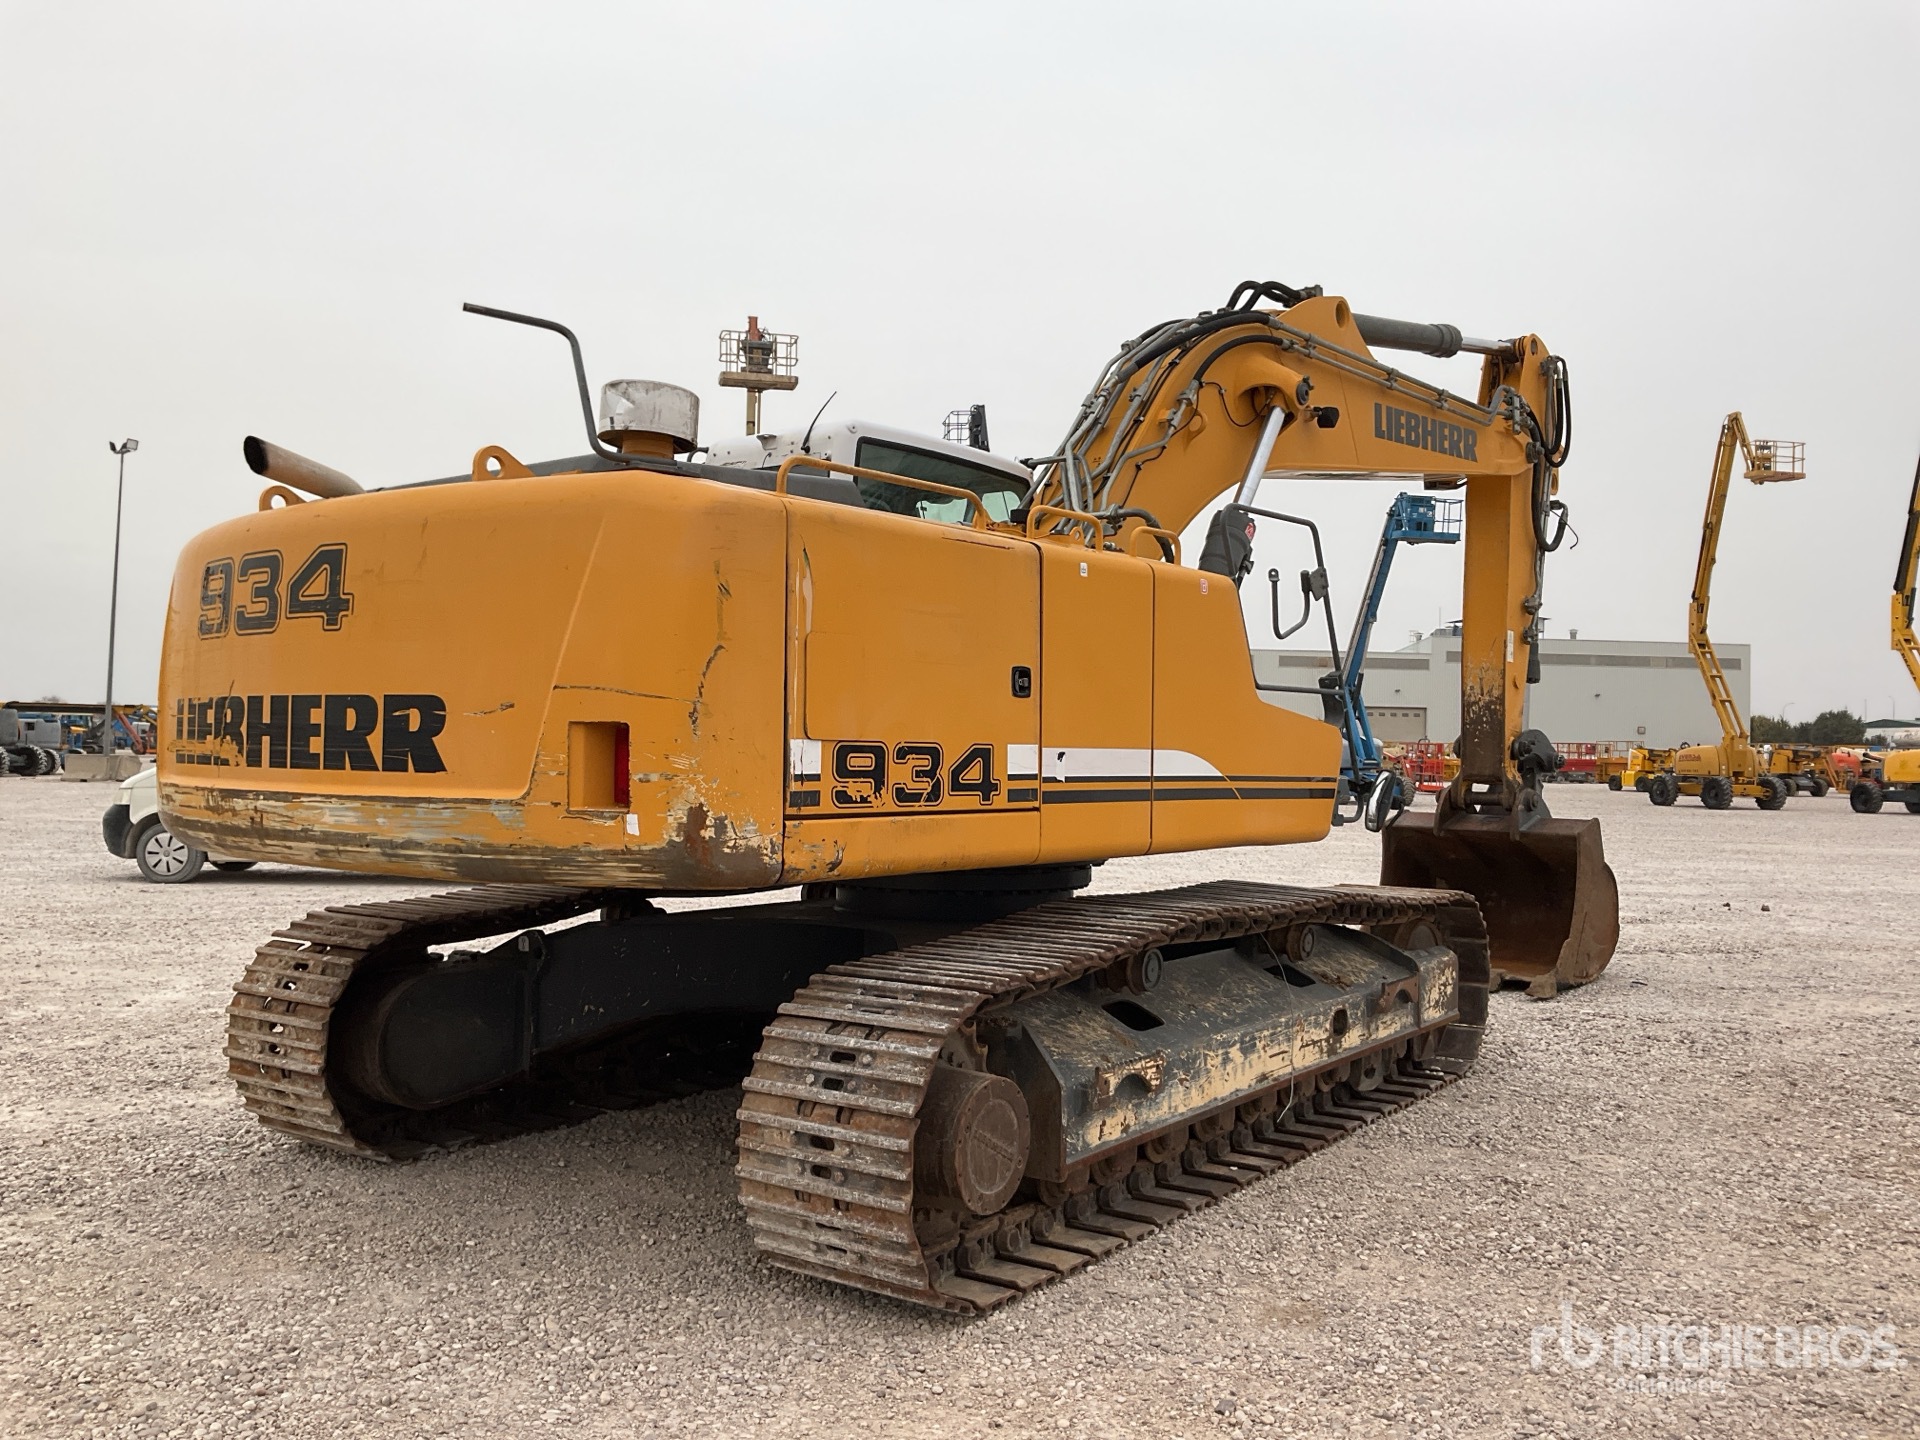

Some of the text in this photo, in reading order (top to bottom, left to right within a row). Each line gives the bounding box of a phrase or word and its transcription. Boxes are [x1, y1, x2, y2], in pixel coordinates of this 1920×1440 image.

[1374, 402, 1478, 463] LIEBHERR
[198, 542, 354, 641] 934
[832, 740, 1000, 809] 934
